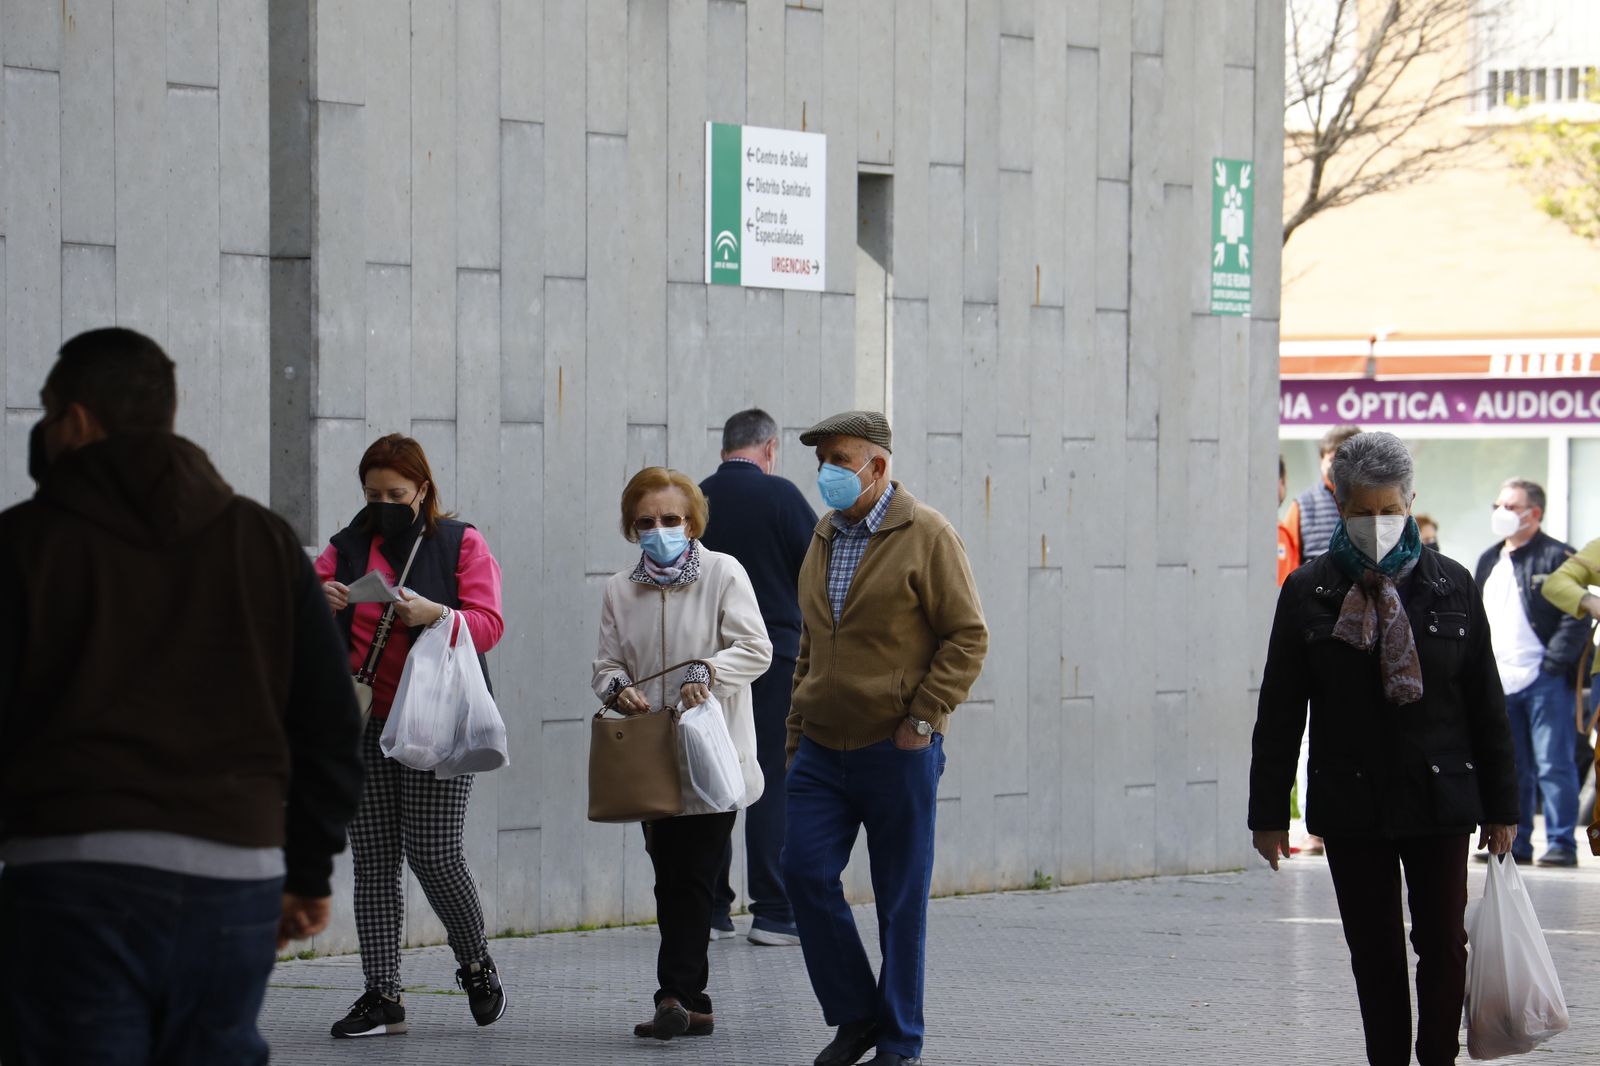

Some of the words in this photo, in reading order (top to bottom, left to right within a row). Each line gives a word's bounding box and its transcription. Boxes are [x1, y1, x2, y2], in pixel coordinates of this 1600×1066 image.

[756, 147, 778, 166] Centro
[780, 150, 788, 166] de
[790, 150, 808, 168] Salud
[756, 177, 780, 195] Distrito
[782, 180, 811, 198] Sanitario
[756, 206, 778, 224] Centro
[780, 208, 788, 225] de
[756, 226, 804, 246] Especialidades
[772, 256, 810, 274] URGENCIAS
[1280, 392, 1313, 419] IA
[1336, 386, 1449, 420] ÓPTICA
